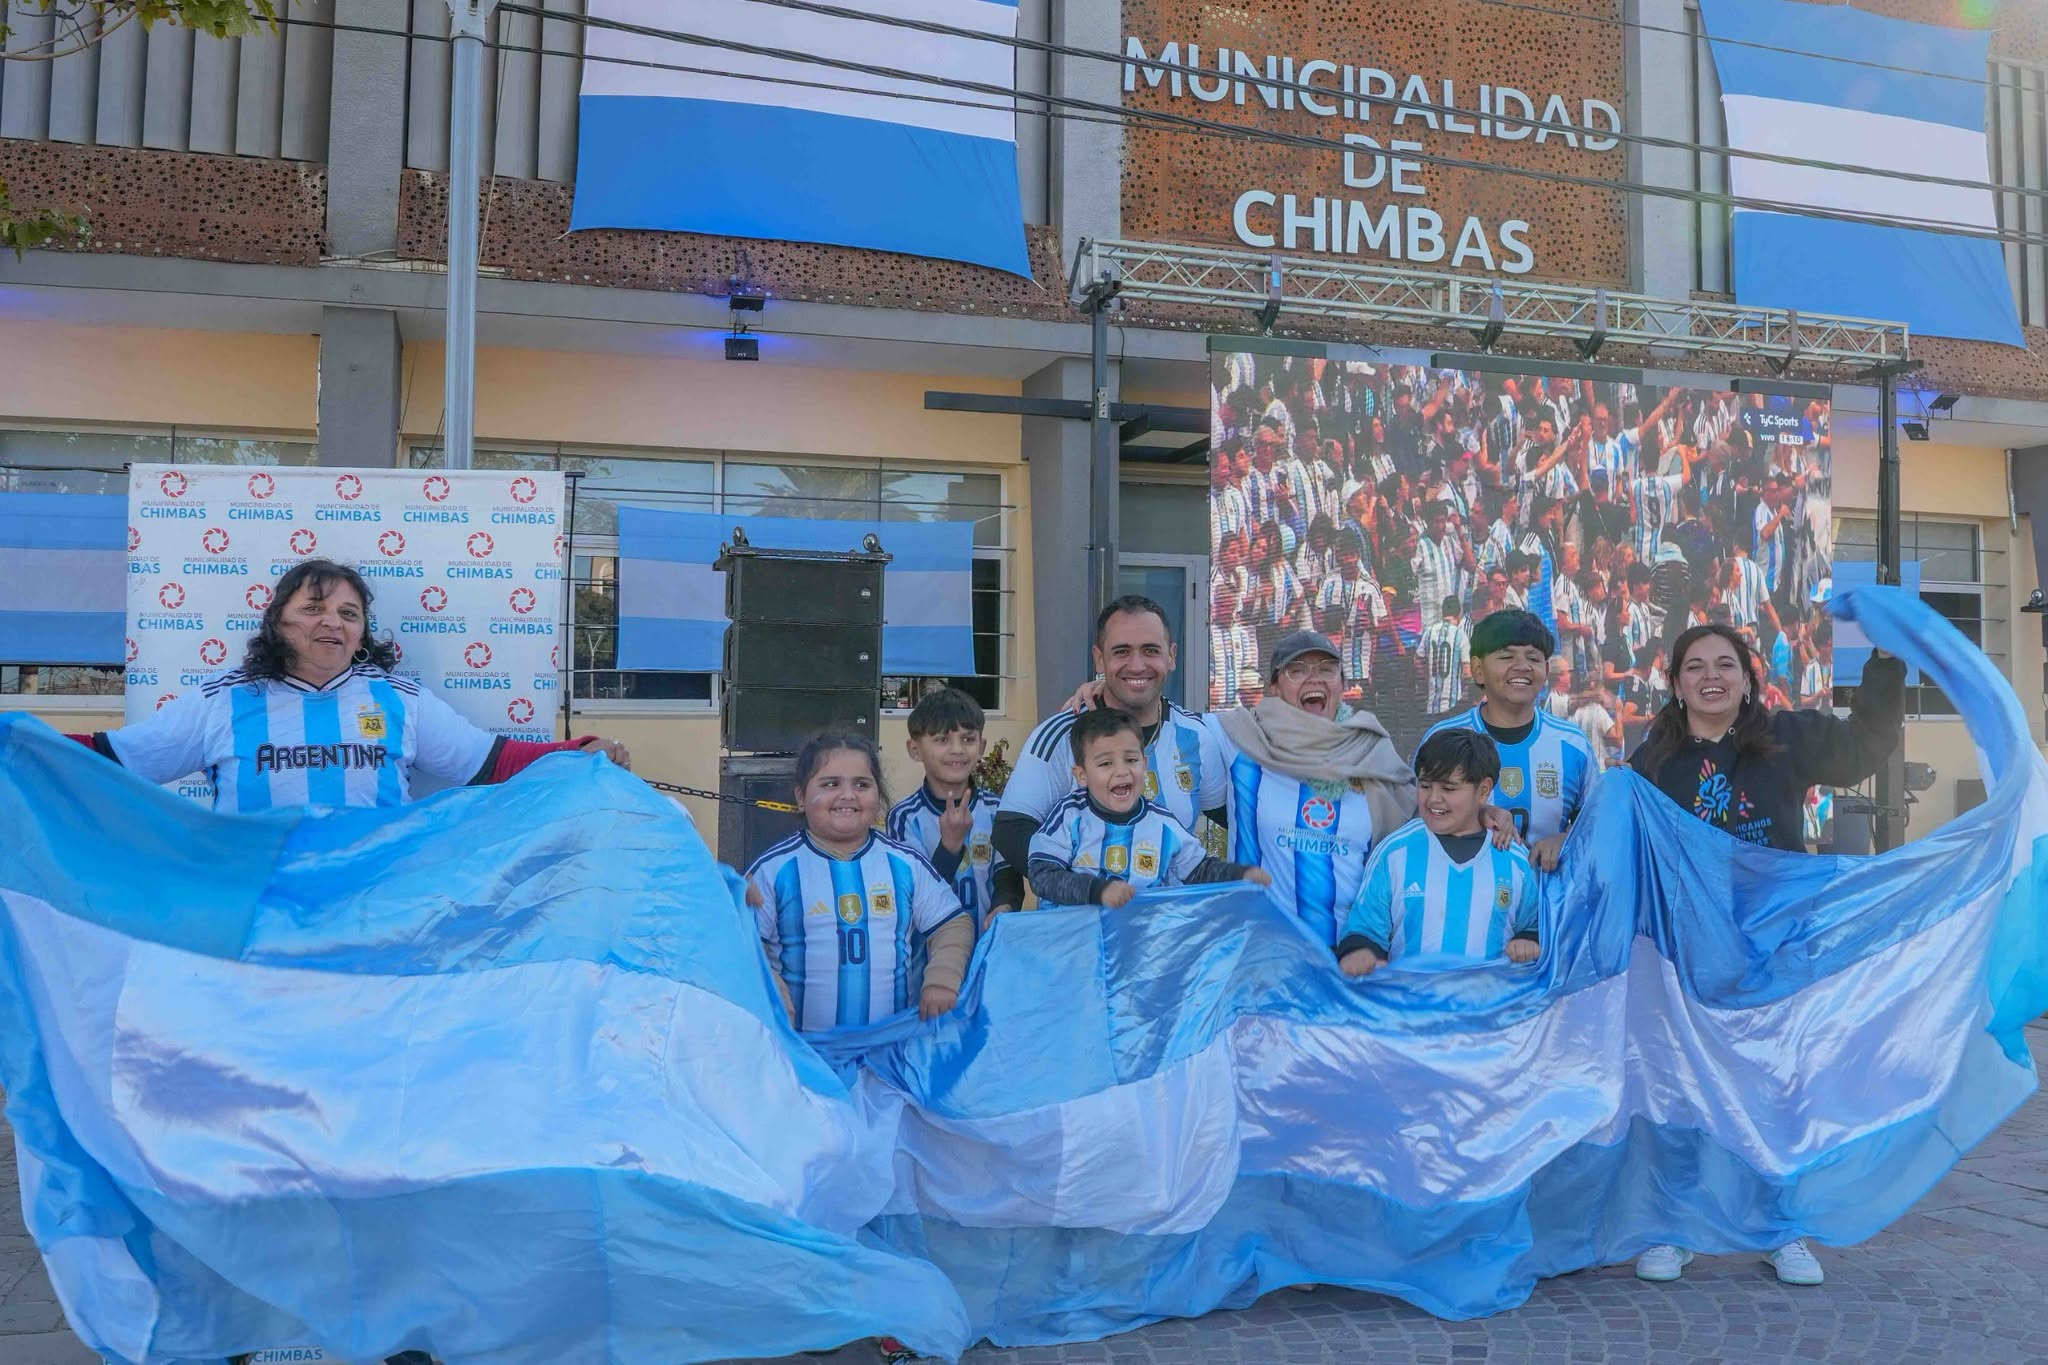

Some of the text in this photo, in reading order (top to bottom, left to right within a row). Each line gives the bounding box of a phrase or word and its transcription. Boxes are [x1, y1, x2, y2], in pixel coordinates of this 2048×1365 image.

[1124, 36, 1621, 151] MUNICIPALIDAD
[1343, 133, 1426, 195] DE
[1233, 190, 1535, 274] CHIMBAS
[1759, 413, 1799, 428] TyC Sports
[140, 507, 207, 519] CHIMBAS
[228, 508, 294, 520] CHIMBAS
[315, 509, 381, 522] CHIMBAS
[403, 511, 469, 523] CHIMBAS
[491, 512, 556, 524] CHIMBAS
[183, 563, 248, 575] CHIMBAS
[358, 566, 424, 578] CHIMBAS
[446, 567, 513, 579] CHIMBAS
[138, 618, 204, 630] CHIMBAS
[226, 619, 262, 631] CHIM
[400, 622, 467, 634] CHIMBAS
[489, 623, 553, 635] CHIMBAS
[444, 678, 511, 690] CHIMBAS
[256, 743, 387, 775] ARGENTINA
[178, 786, 214, 798] CHIM
[1276, 834, 1349, 856] CHIMBAS
[836, 927, 866, 966] 10
[254, 1348, 323, 1363] CHIMBAS
